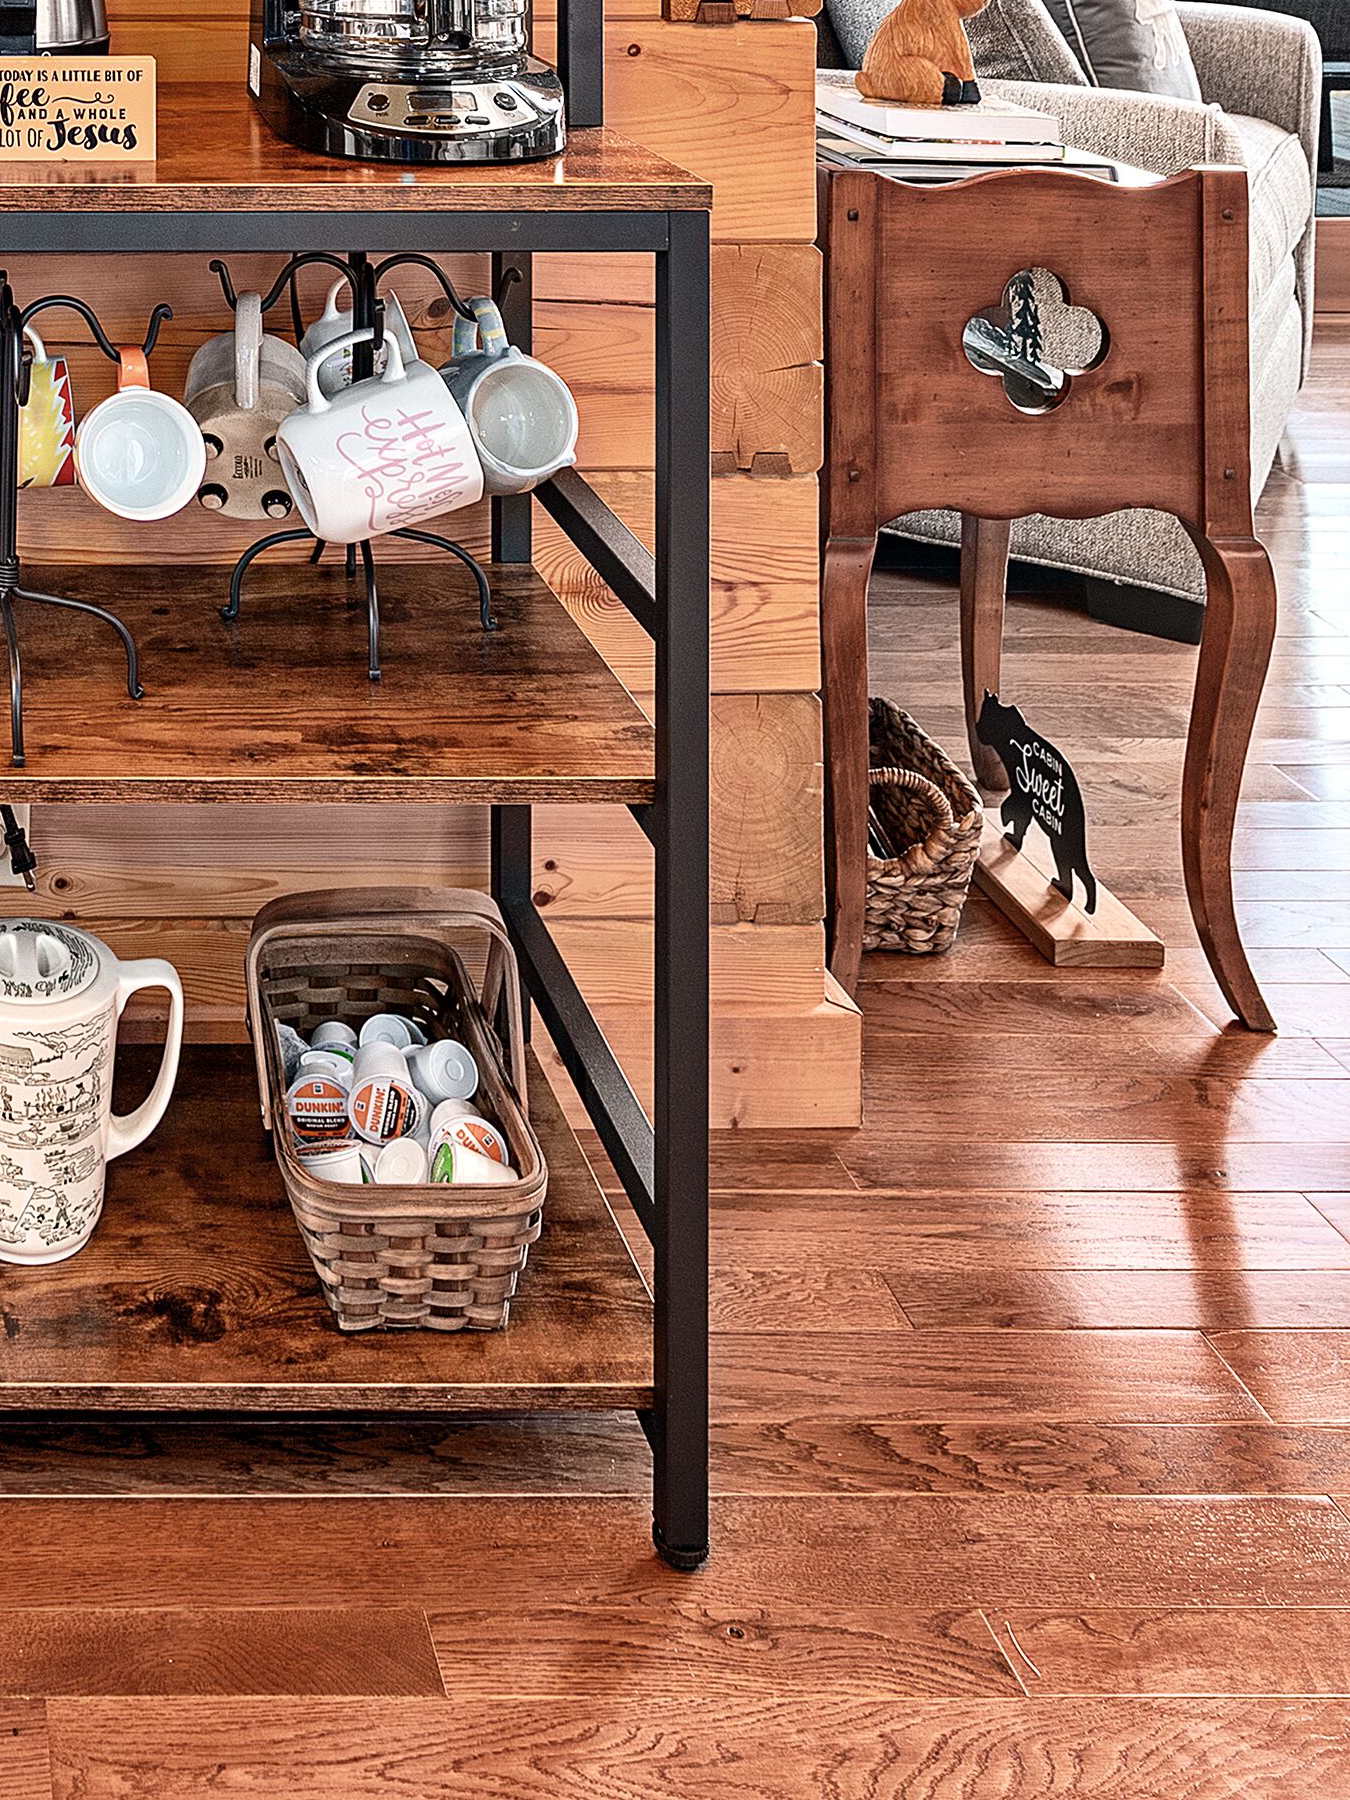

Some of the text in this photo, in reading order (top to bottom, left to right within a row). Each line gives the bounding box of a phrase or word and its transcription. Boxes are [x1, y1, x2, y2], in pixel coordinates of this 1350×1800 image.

[37, 69, 49, 82] IS
[51, 69, 59, 82] A
[62, 69, 101, 82] LITTLE
[104, 69, 123, 82] BIT
[127, 69, 143, 82] OF
[17, 108, 127, 120] AND A WHOLE
[0, 118, 138, 151] LOT OF Jesus
[396, 408, 456, 466] Hot
[418, 462, 469, 512] Mess
[1033, 741, 1063, 777] CABIN
[1009, 738, 1065, 817] Sweet
[1032, 798, 1062, 835] CABIN
